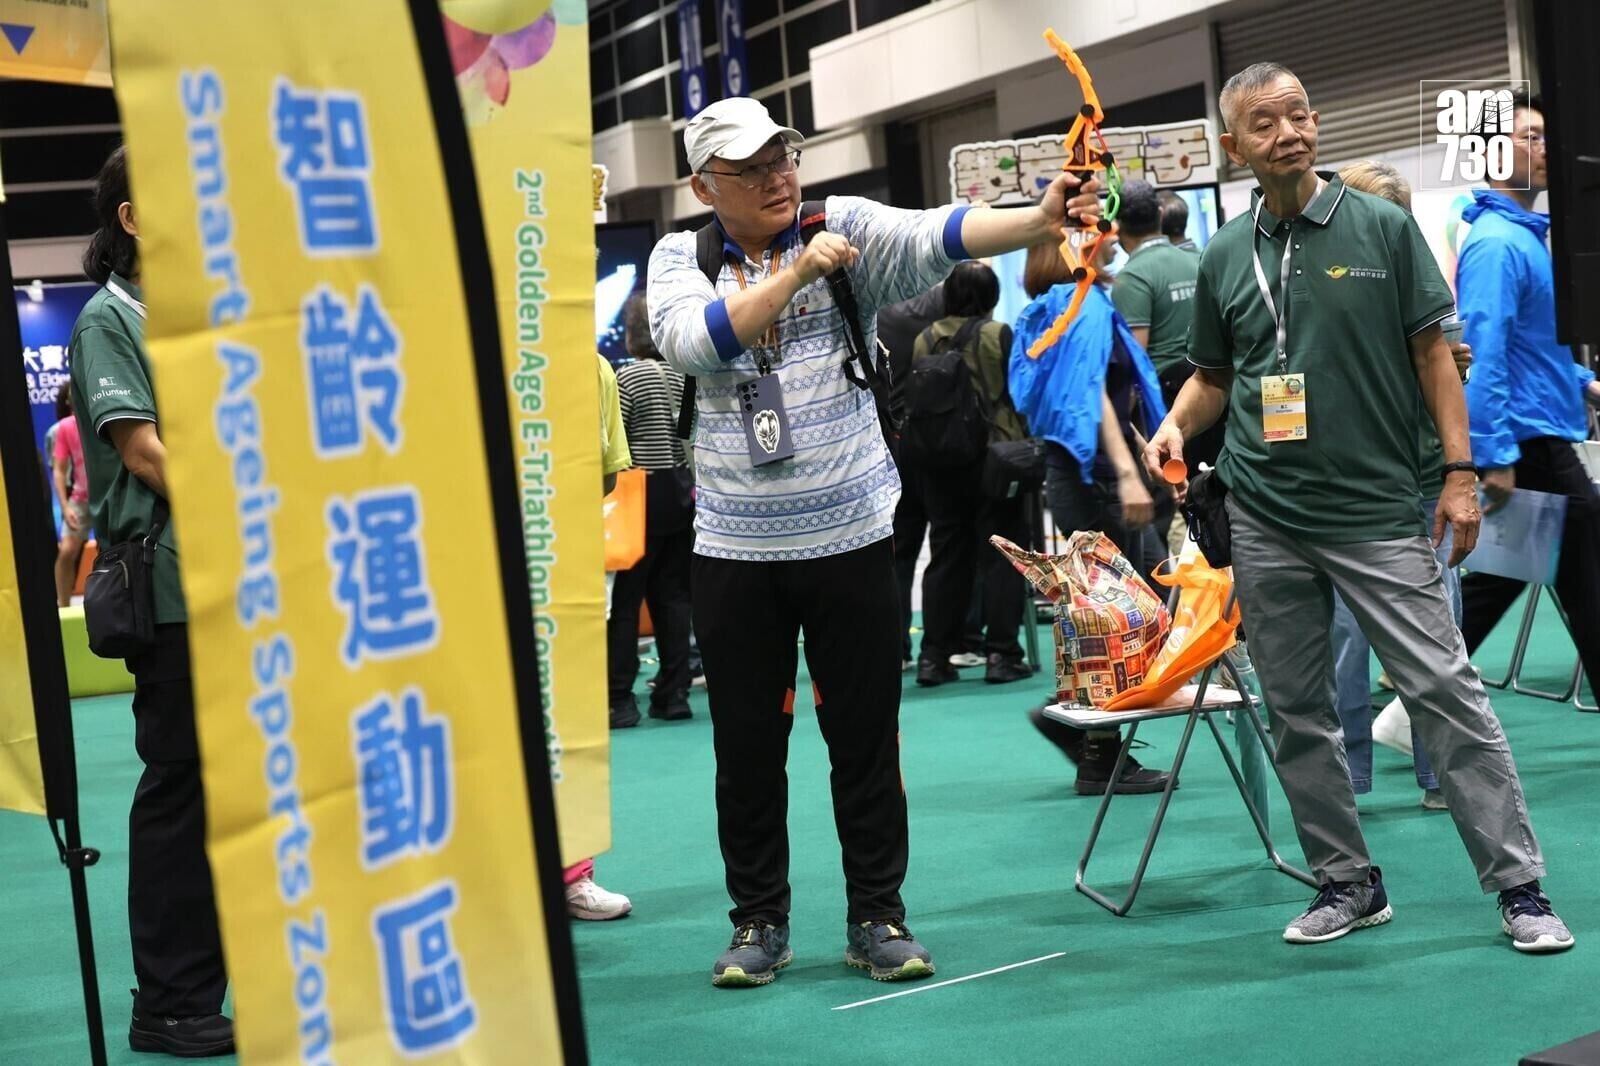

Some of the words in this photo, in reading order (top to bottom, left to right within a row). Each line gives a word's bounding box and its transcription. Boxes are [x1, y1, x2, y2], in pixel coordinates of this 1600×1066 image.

[516, 170, 545, 216] 2nd
[517, 224, 546, 342] Golden
[513, 350, 546, 412] Age
[180, 74, 249, 327] Smart
[215, 346, 280, 623] Ageing
[251, 637, 311, 899] Sports
[289, 910, 334, 1066] Zon
[276, 82, 474, 1051] 智齡運動區
[522, 421, 555, 608] E-Triathlon
